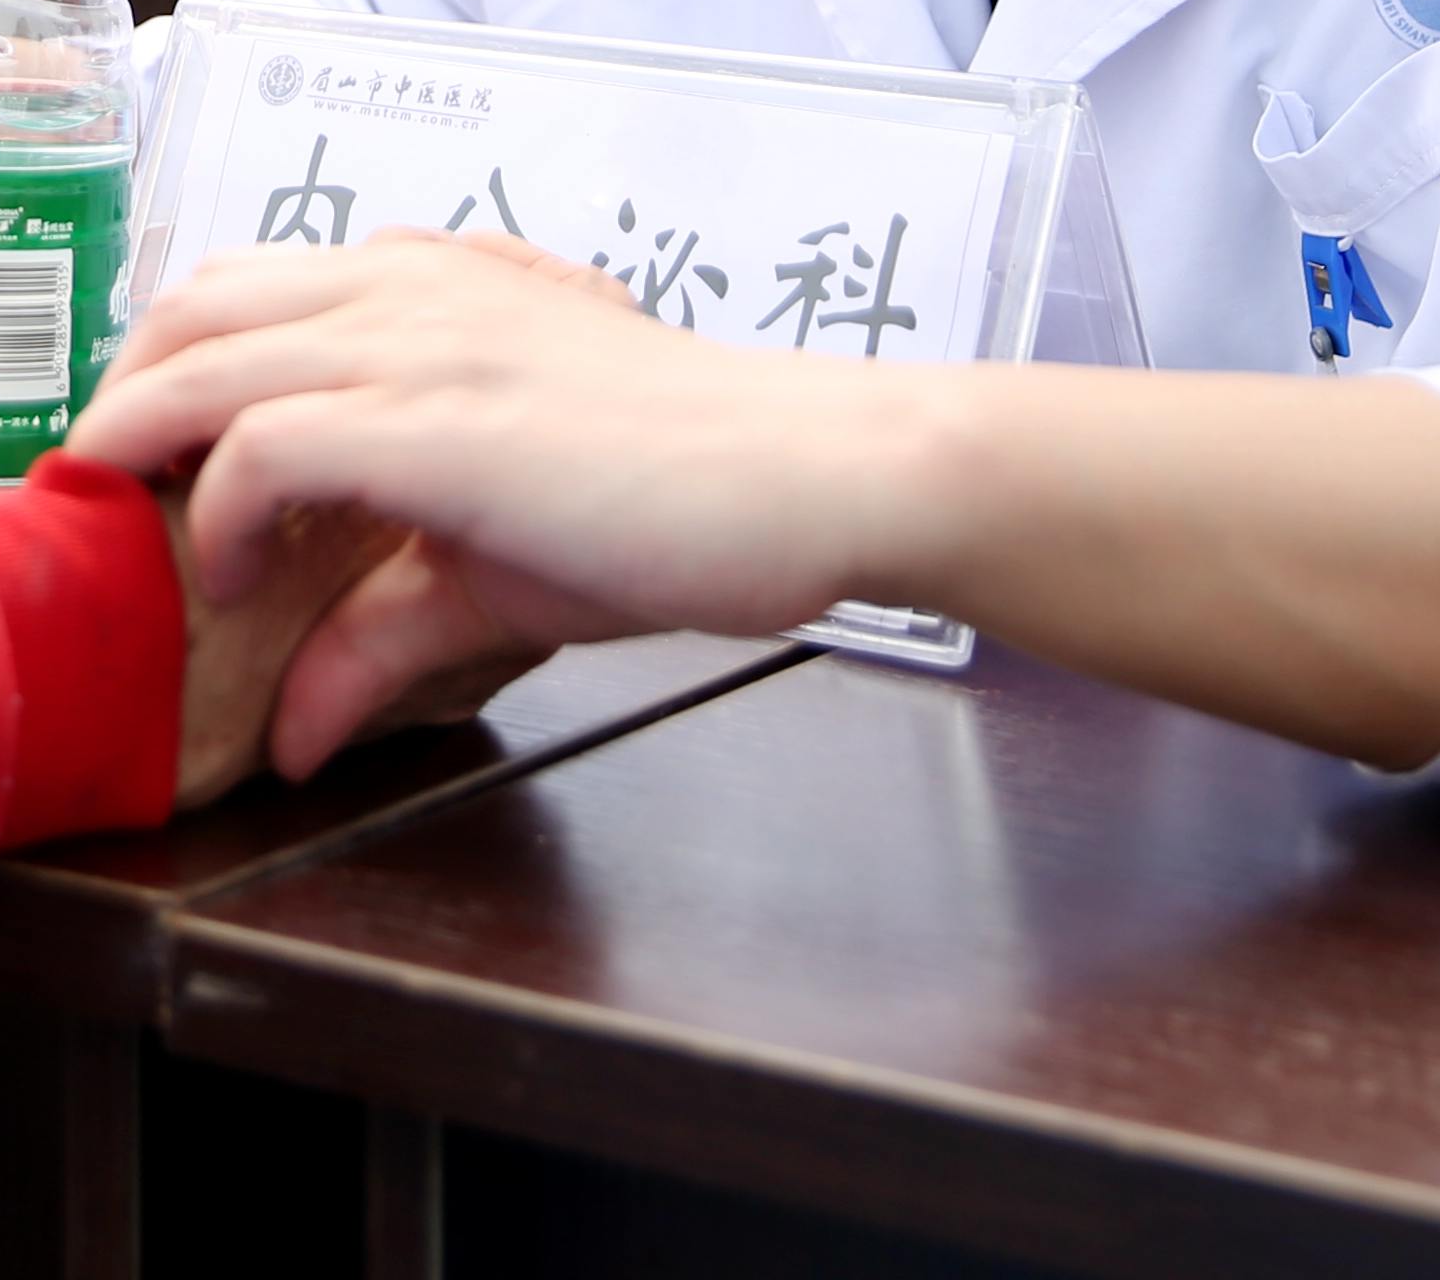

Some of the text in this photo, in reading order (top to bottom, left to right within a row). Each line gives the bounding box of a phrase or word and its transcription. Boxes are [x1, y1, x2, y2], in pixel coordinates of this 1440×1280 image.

[309, 66, 493, 114] 眉山市中医医院
[312, 99, 480, 132] www.mstcm.com.cn
